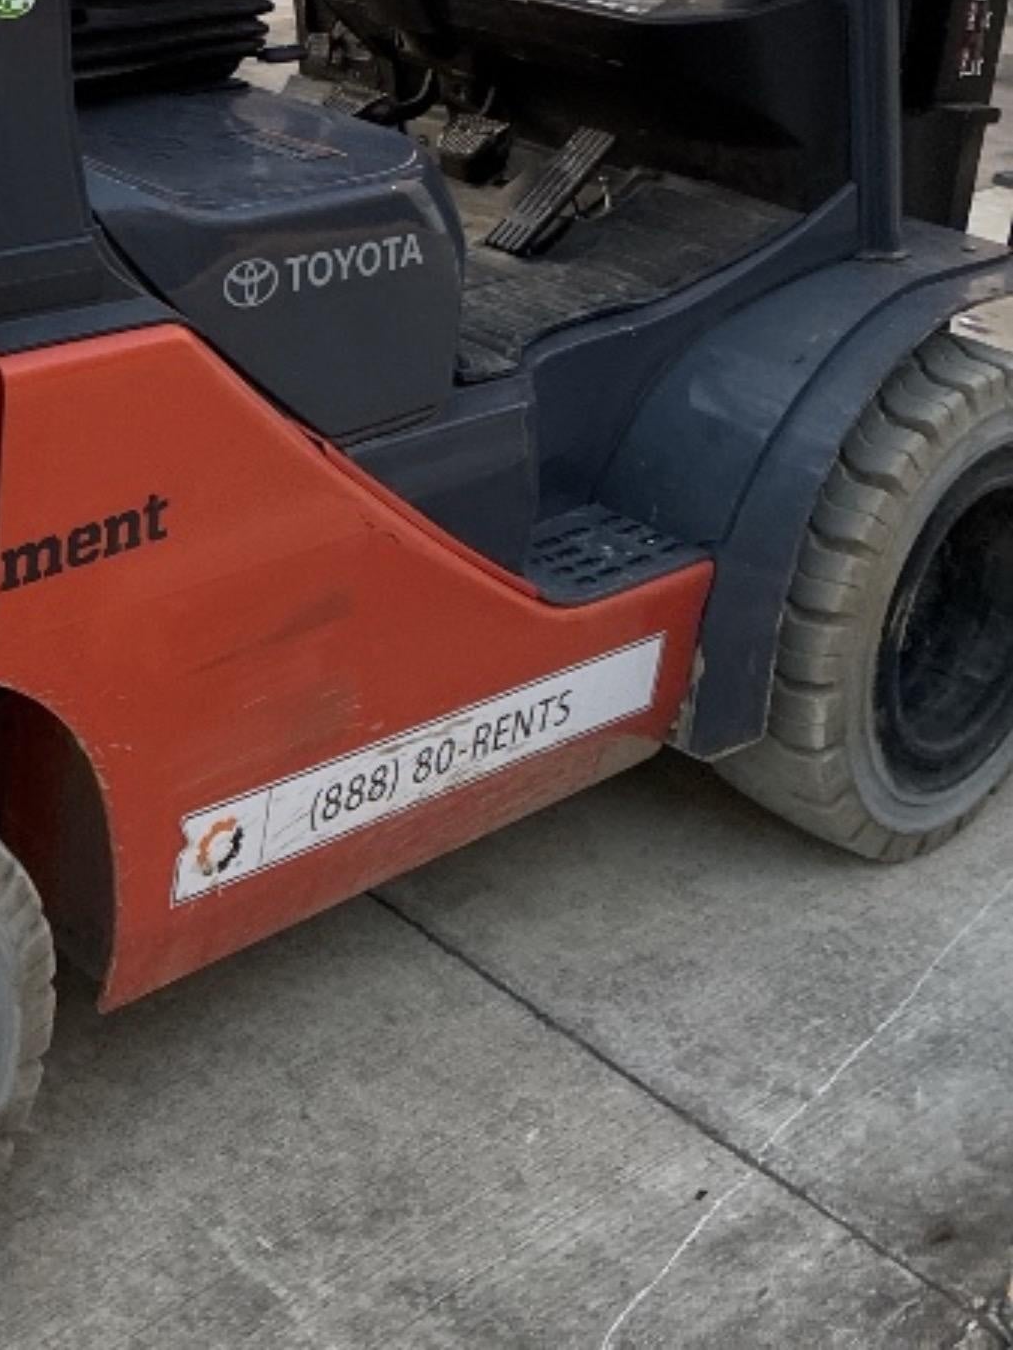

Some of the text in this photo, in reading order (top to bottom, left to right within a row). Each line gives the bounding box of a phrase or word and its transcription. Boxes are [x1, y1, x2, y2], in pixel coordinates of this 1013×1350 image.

[285, 233, 424, 292] TOYOTA
[309, 689, 574, 831] (888) 80-RENTS
